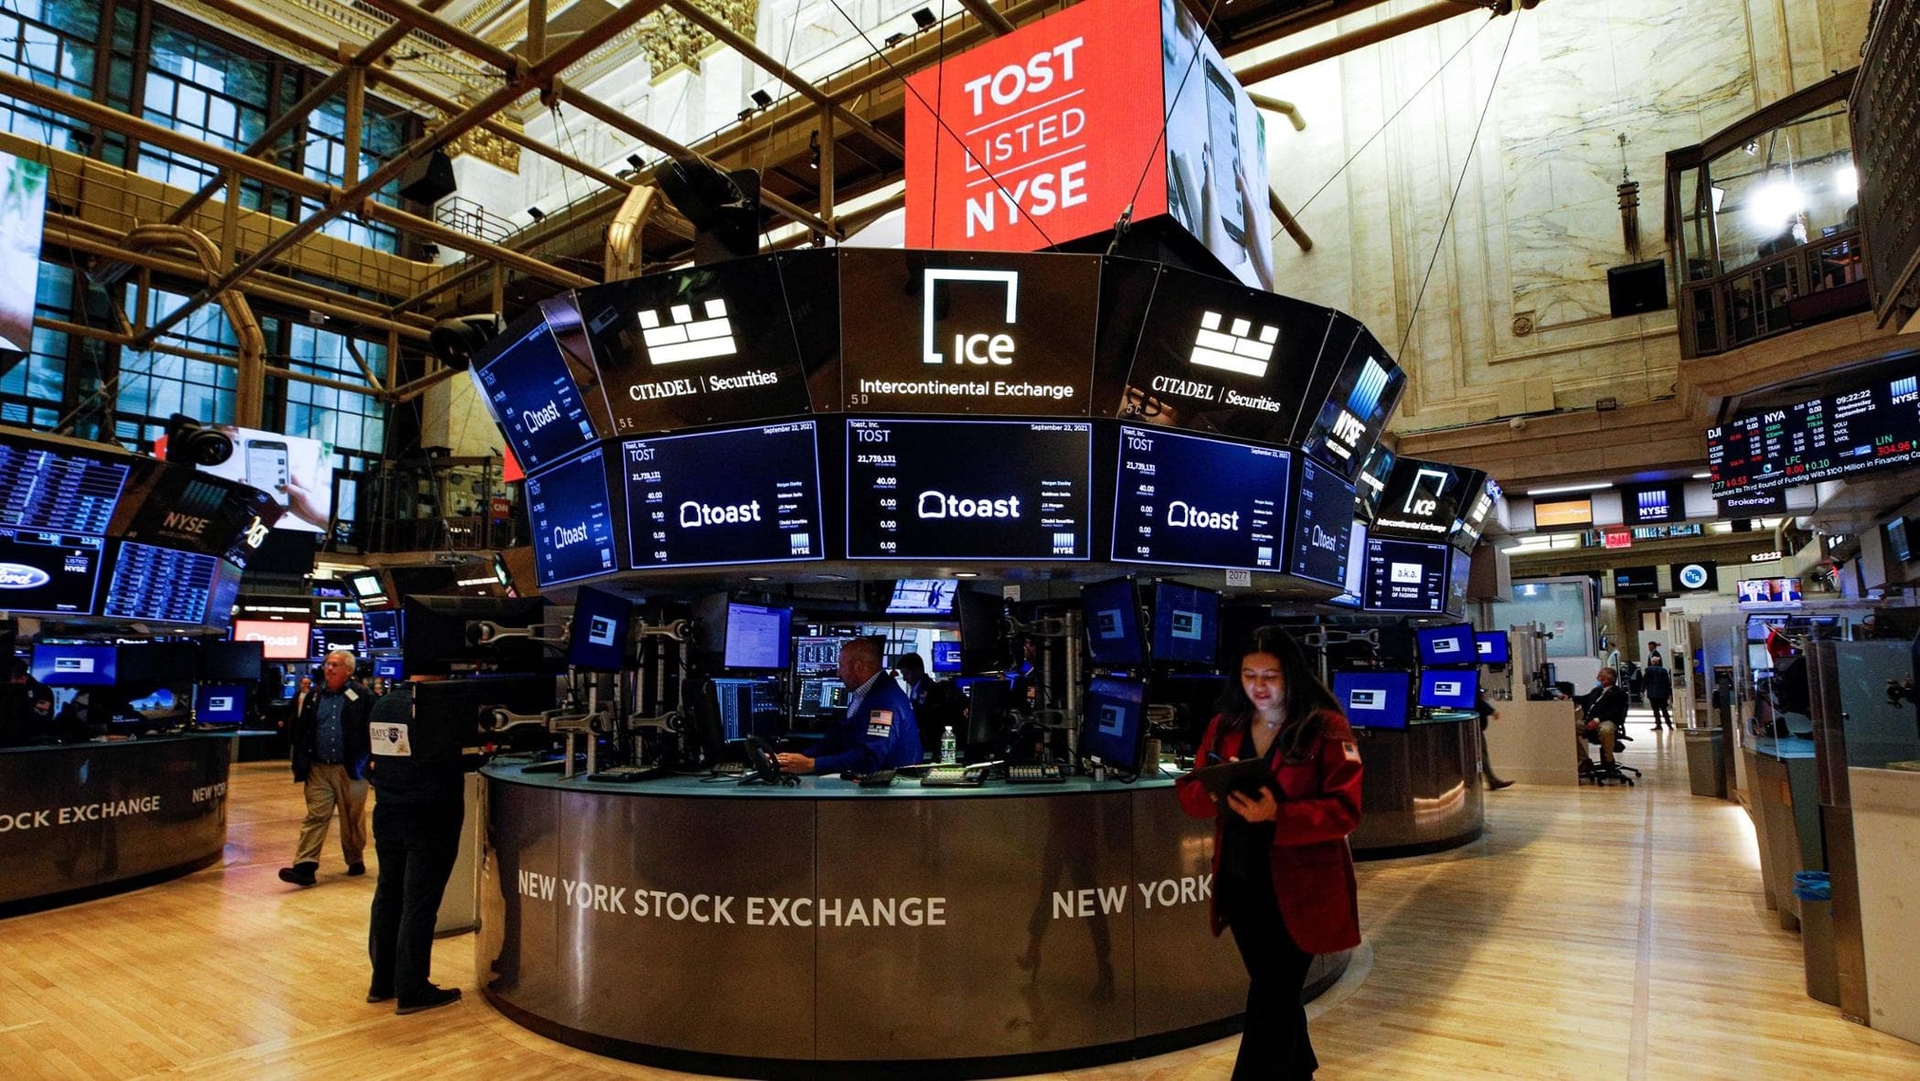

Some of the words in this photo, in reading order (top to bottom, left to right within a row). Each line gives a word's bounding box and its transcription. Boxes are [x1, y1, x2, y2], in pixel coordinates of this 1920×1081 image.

[964, 36, 1084, 117] TOST
[965, 107, 1086, 173] LISTED
[965, 160, 1088, 238] NYSE
[629, 379, 697, 401] CITADEL
[709, 370, 779, 392] Securities
[859, 378, 990, 397] Intercontinental
[994, 381, 1075, 400] Exchange
[1152, 375, 1215, 401] CITADEL
[1225, 389, 1281, 413] Securities
[1836, 389, 1871, 405] 09:22:22
[1892, 391, 1919, 405] NYSE
[1808, 405, 1822, 414] 0.00
[1836, 399, 1872, 412] Wednesday
[532, 400, 561, 428] toast
[1764, 410, 1786, 424] NYA
[1834, 407, 1867, 419] September
[763, 425, 791, 435] September
[1030, 424, 1063, 432] September
[1074, 424, 1088, 432] 2021
[1332, 409, 1367, 448] NYSE
[1746, 422, 1759, 430] 0.00
[1832, 421, 1848, 429] VOLU
[856, 429, 891, 442] TOST
[1707, 427, 1722, 440] DJI
[1833, 428, 1849, 436] DVOL
[1127, 437, 1154, 452] TOST
[1834, 435, 1850, 443] UVOL
[1875, 434, 1893, 446] LIN
[630, 448, 655, 462] TOST
[1877, 441, 1911, 456] 304.96
[857, 455, 897, 463] 21,739,131
[1784, 455, 1801, 466] LFC
[1743, 484, 1758, 492] Third
[1758, 480, 1777, 489] Round
[1784, 474, 1810, 484] Funding
[1810, 470, 1826, 479] With
[1826, 466, 1843, 476] $100
[1843, 462, 1866, 472] Million
[1874, 453, 1910, 466] Financing
[1785, 464, 1805, 475] 8.00
[1810, 458, 1830, 470] 0.10
[876, 477, 897, 485] 40.00
[493, 503, 508, 513] CNN
[947, 495, 1020, 518] toast
[1728, 496, 1776, 507] Brokerage
[701, 500, 761, 525] toast
[1140, 505, 1153, 513] 0.00
[1639, 506, 1668, 516] NYSE
[163, 511, 209, 534] NYSE
[1188, 502, 1239, 532] toast
[880, 520, 897, 528] 0.00
[1421, 523, 1447, 533] Exchange
[563, 521, 589, 546] toast
[1318, 528, 1337, 552] toast
[1608, 532, 1629, 546] EXIT
[654, 551, 667, 559] 0.00
[791, 547, 810, 555] NYSE
[1053, 547, 1074, 555] NYSE
[1137, 546, 1150, 554] 0.00
[64, 565, 87, 573] NYSE
[1257, 558, 1271, 567] NYSE
[1228, 571, 1248, 580] 2077
[1397, 568, 1418, 578] a.k.a.
[264, 634, 299, 646] toast
[192, 784, 214, 803] NEW
[213, 781, 228, 798] YOR
[0, 809, 50, 832] OCK
[58, 795, 161, 825] EXCHANGE
[518, 869, 556, 902] NEW
[561, 878, 627, 915] YORK
[633, 889, 736, 925] STOCK
[746, 897, 947, 927] EXCHANGE
[1052, 885, 1128, 919] NEW
[1138, 873, 1213, 909] YORK
